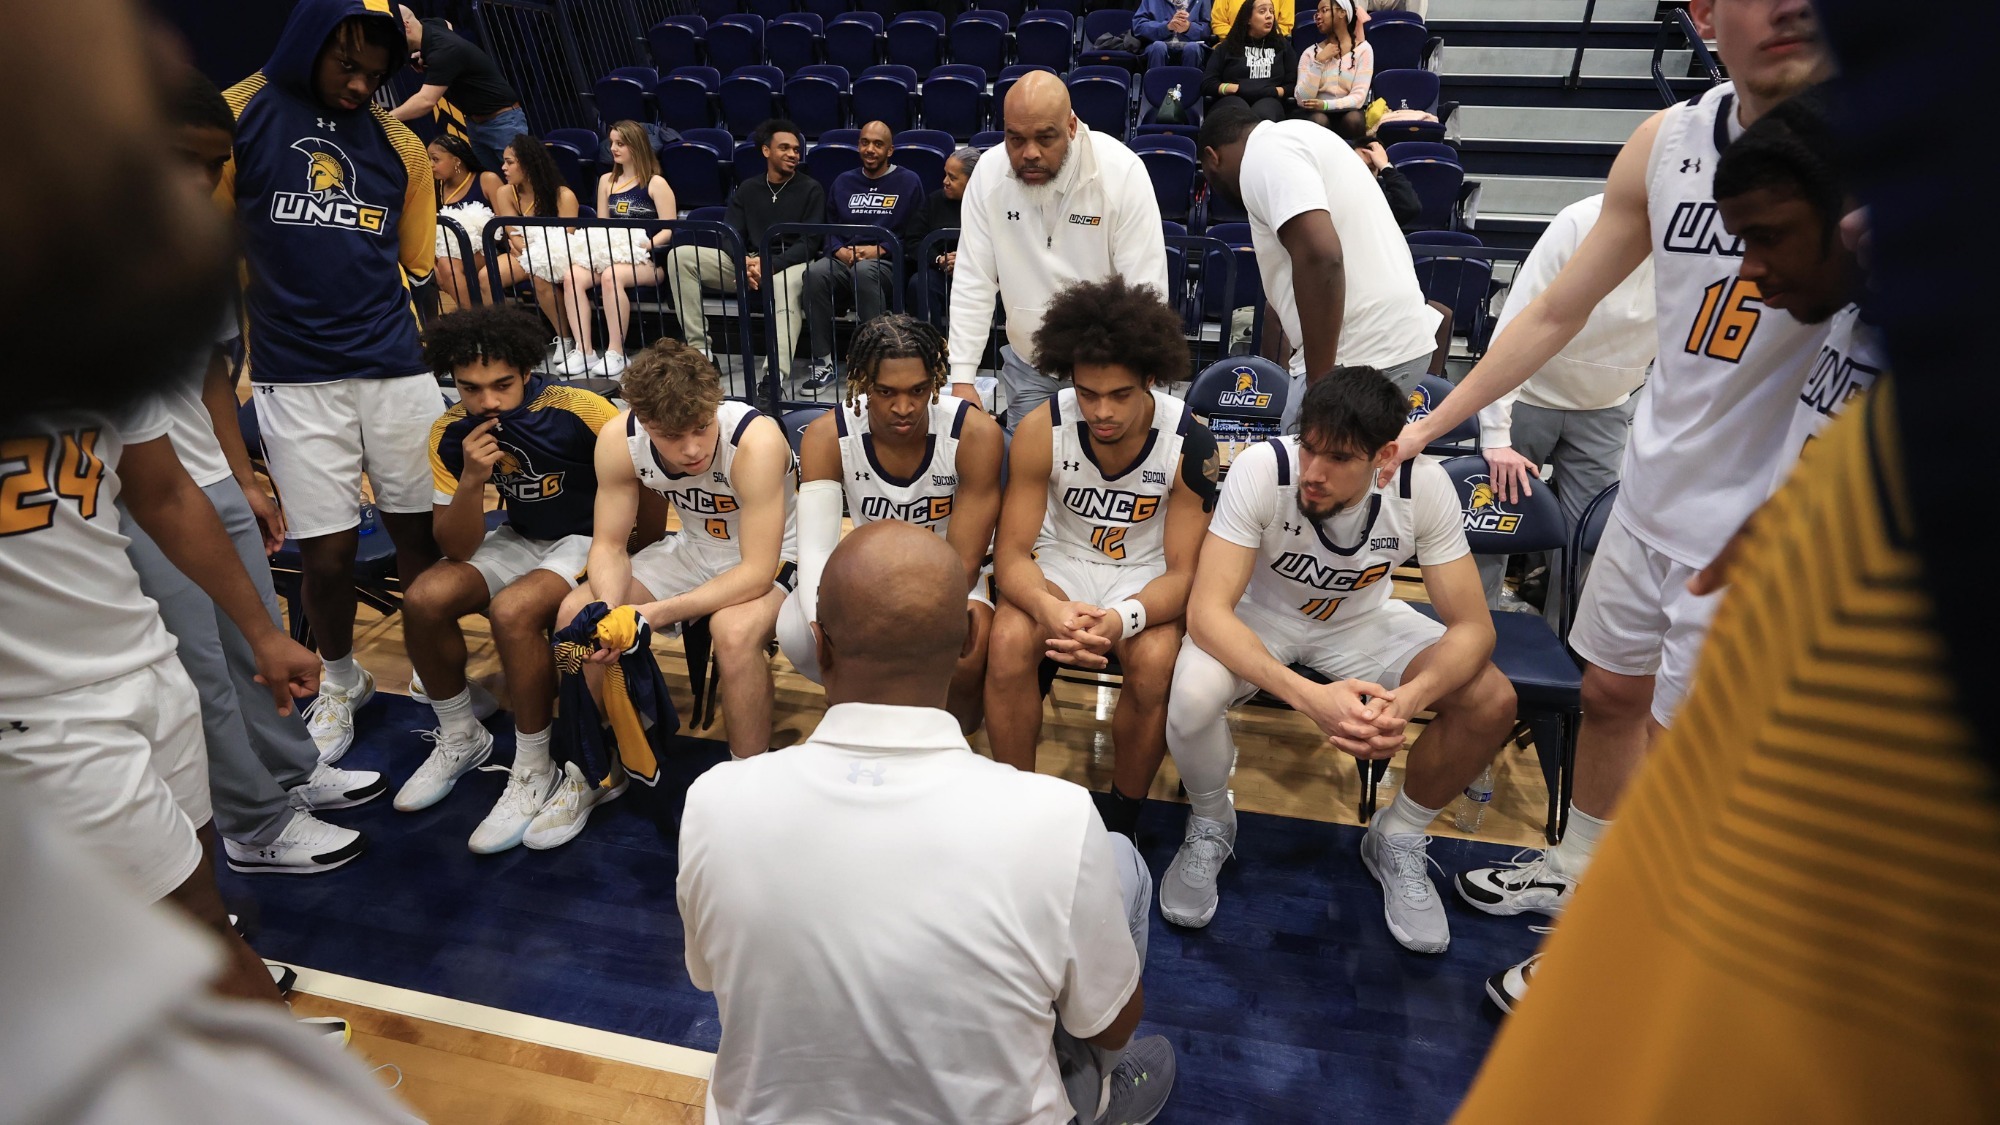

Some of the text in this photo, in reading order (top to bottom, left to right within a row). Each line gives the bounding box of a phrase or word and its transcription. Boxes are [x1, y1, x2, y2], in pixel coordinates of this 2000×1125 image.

[1250, 65, 1271, 79] FATHER
[616, 201, 629, 213] G
[849, 194, 898, 208] UNCG
[273, 195, 385, 231] UNCG
[1069, 214, 1101, 225] UNCG
[1685, 275, 1761, 364] 16
[1220, 392, 1271, 407] UNCG
[0, 427, 105, 537] 24
[932, 474, 957, 486] SOCON
[1142, 470, 1166, 485] SOCON
[861, 495, 953, 524] UNCG
[1063, 488, 1161, 523] UNCG
[1091, 526, 1129, 560] 12
[1370, 537, 1399, 551] SOCON
[1271, 552, 1391, 591] UNCG
[1298, 597, 1347, 621] 11
